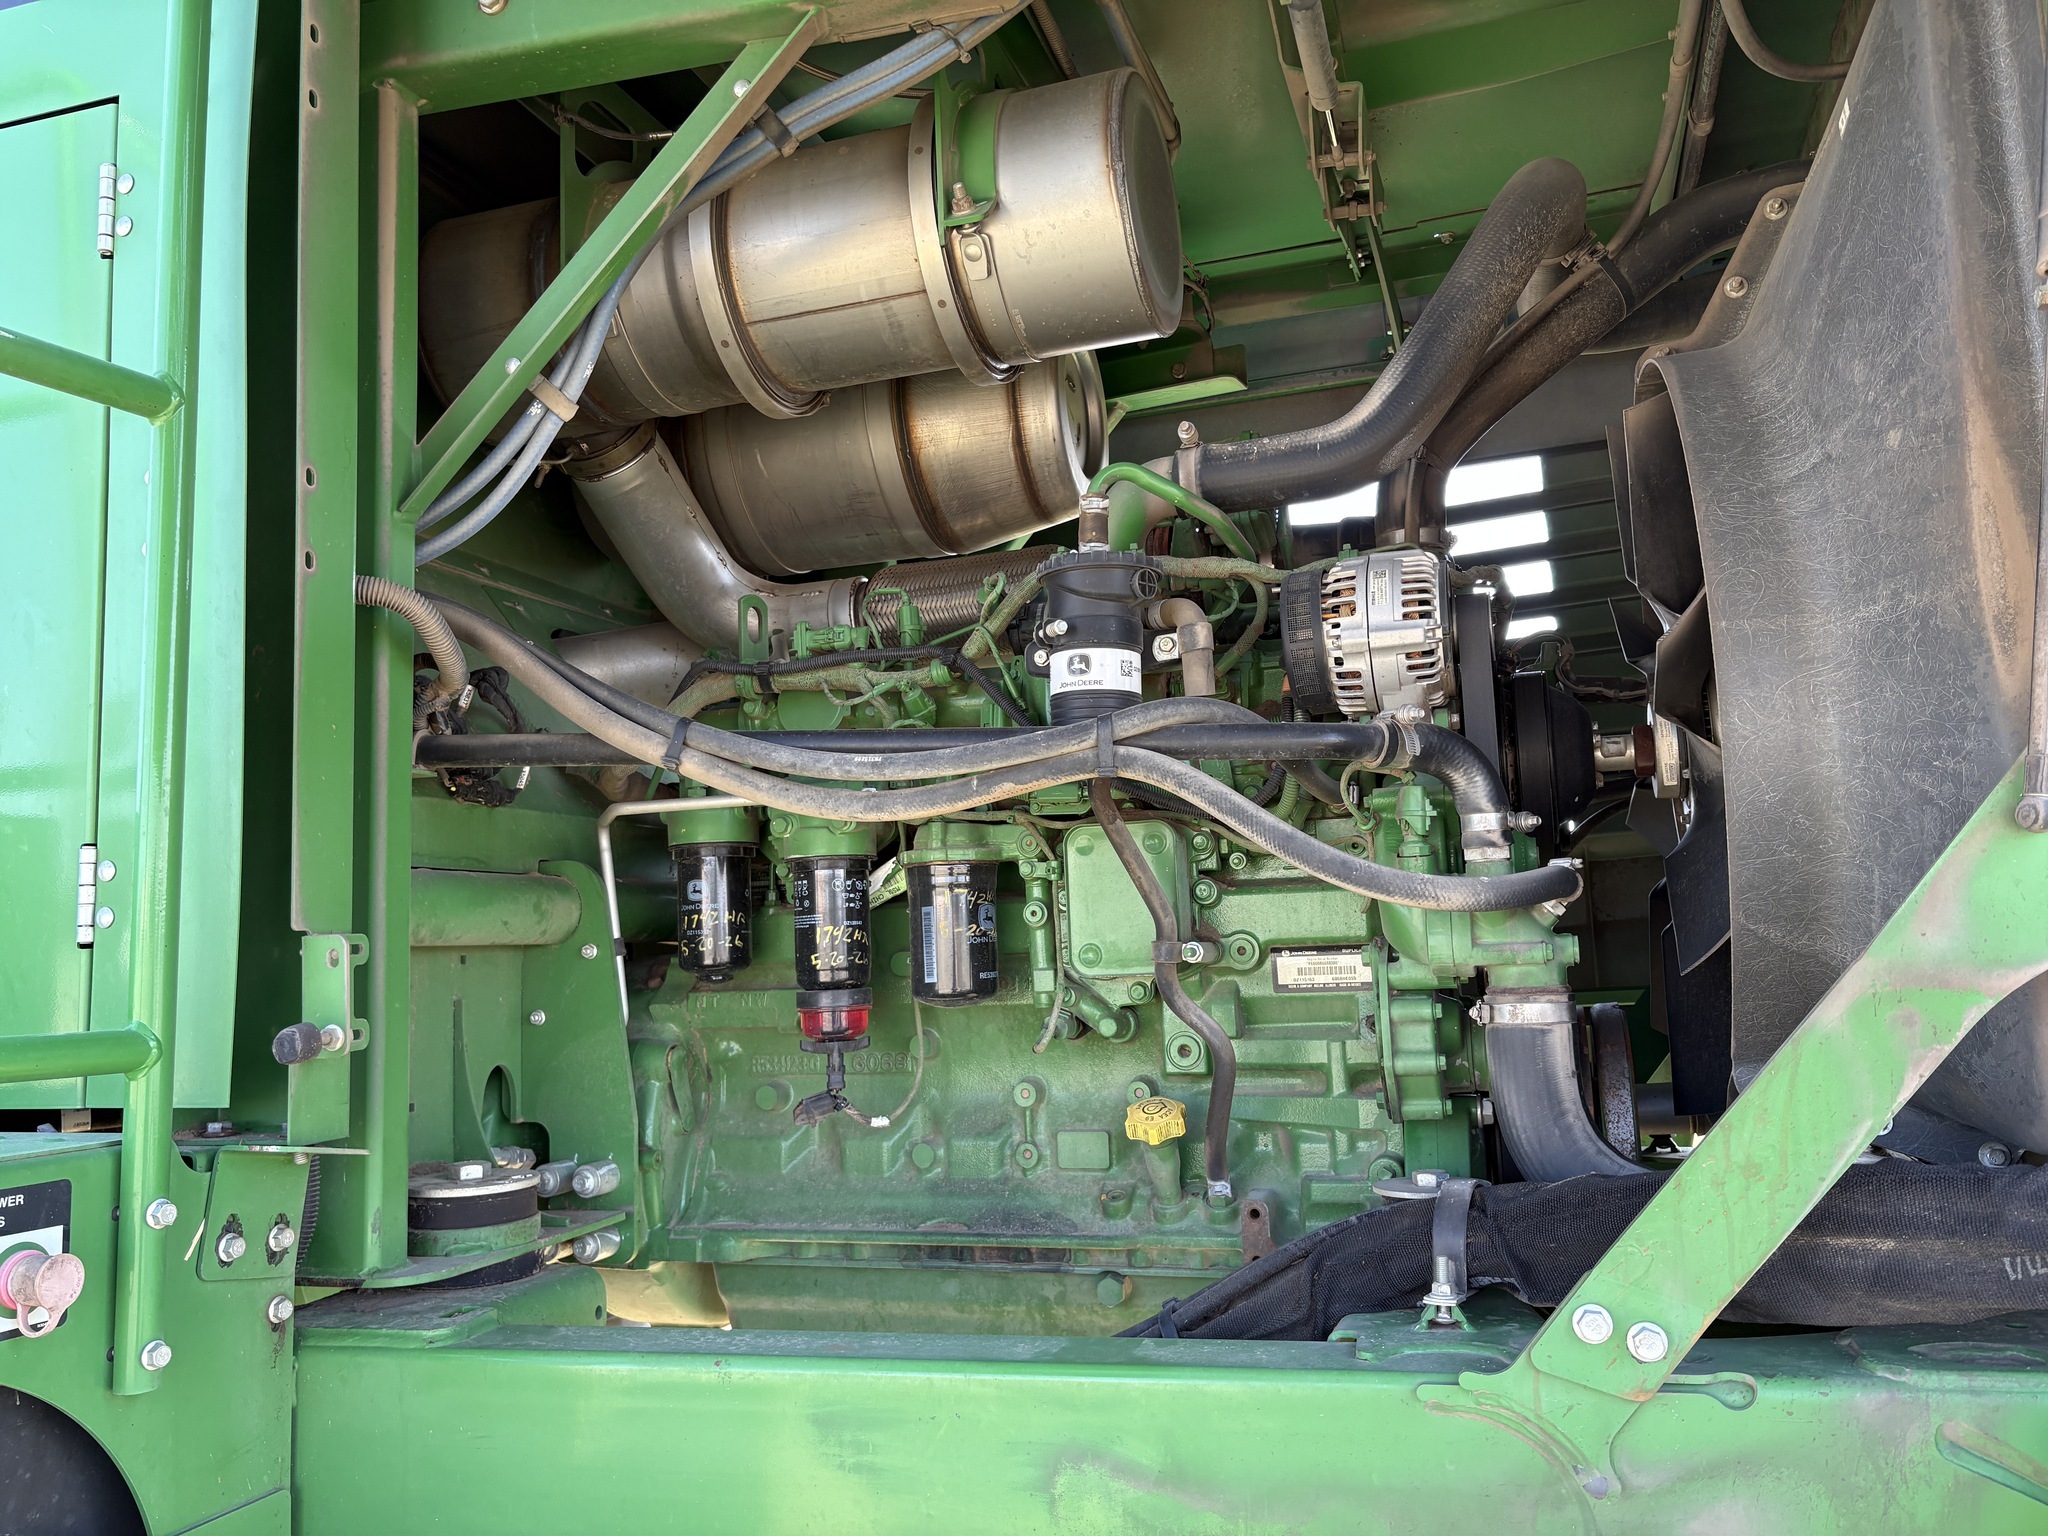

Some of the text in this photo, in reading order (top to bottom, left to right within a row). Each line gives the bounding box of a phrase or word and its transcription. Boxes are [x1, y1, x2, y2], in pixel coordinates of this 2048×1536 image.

[1059, 679, 1104, 689] JOHN DEERE
[681, 904, 695, 912] JOHN
[966, 935, 989, 944] JOHN
